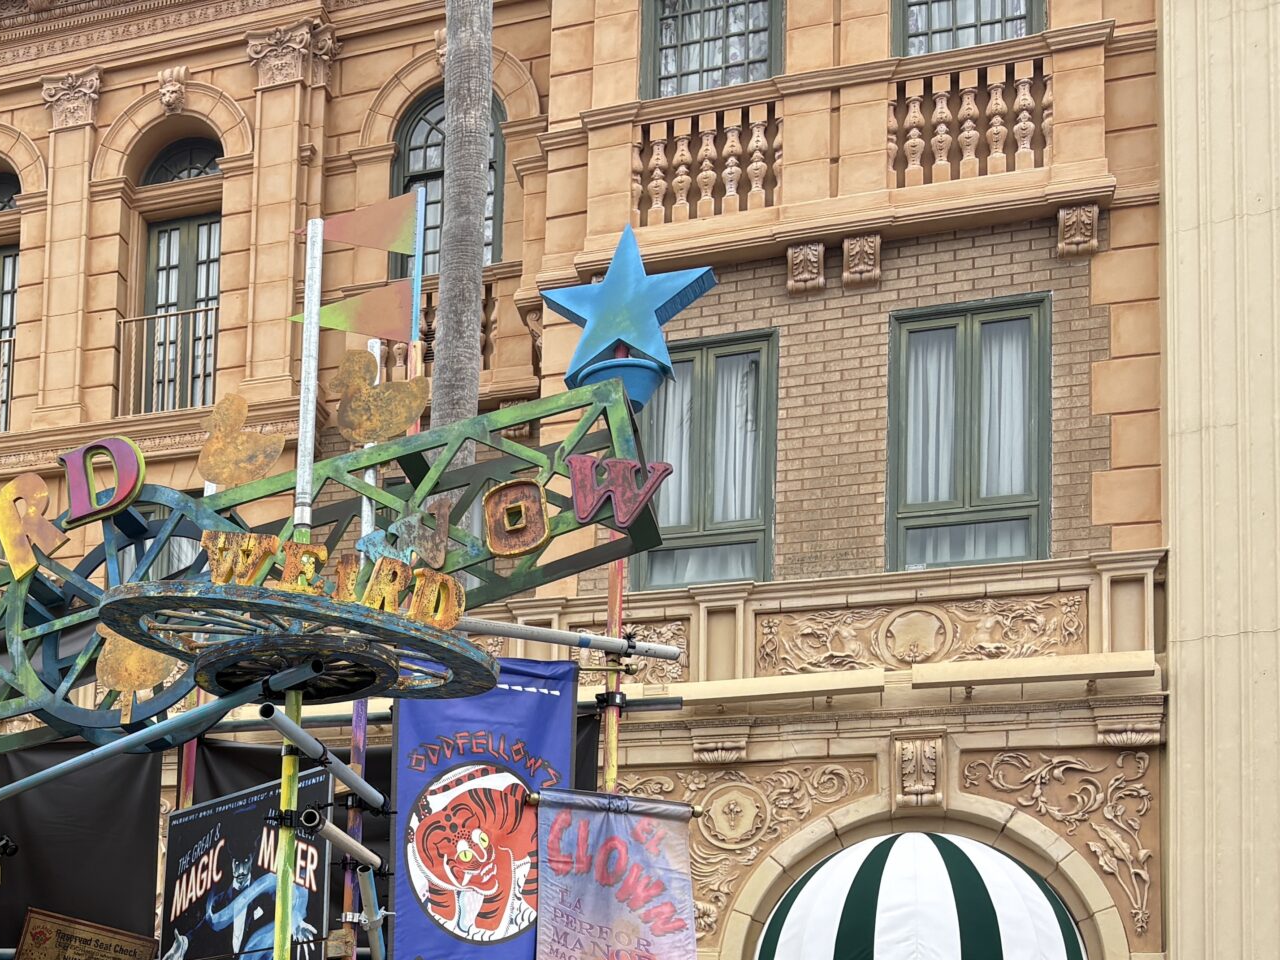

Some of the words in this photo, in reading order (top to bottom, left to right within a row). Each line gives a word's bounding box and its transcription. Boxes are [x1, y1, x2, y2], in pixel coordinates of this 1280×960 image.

[201, 530, 466, 631] WEIRD
[407, 729, 562, 788] ODDFELLOW'S
[177, 850, 191, 875] THE
[191, 827, 215, 864] GREAT
[547, 806, 688, 937] CLOWN
[170, 838, 226, 922] MAGIC
[558, 887, 585, 916] LA
[55, 928, 93, 946] Reserved
[93, 938, 113, 952] Seat
[113, 944, 138, 958] Check
[551, 906, 654, 956] PERFOR
